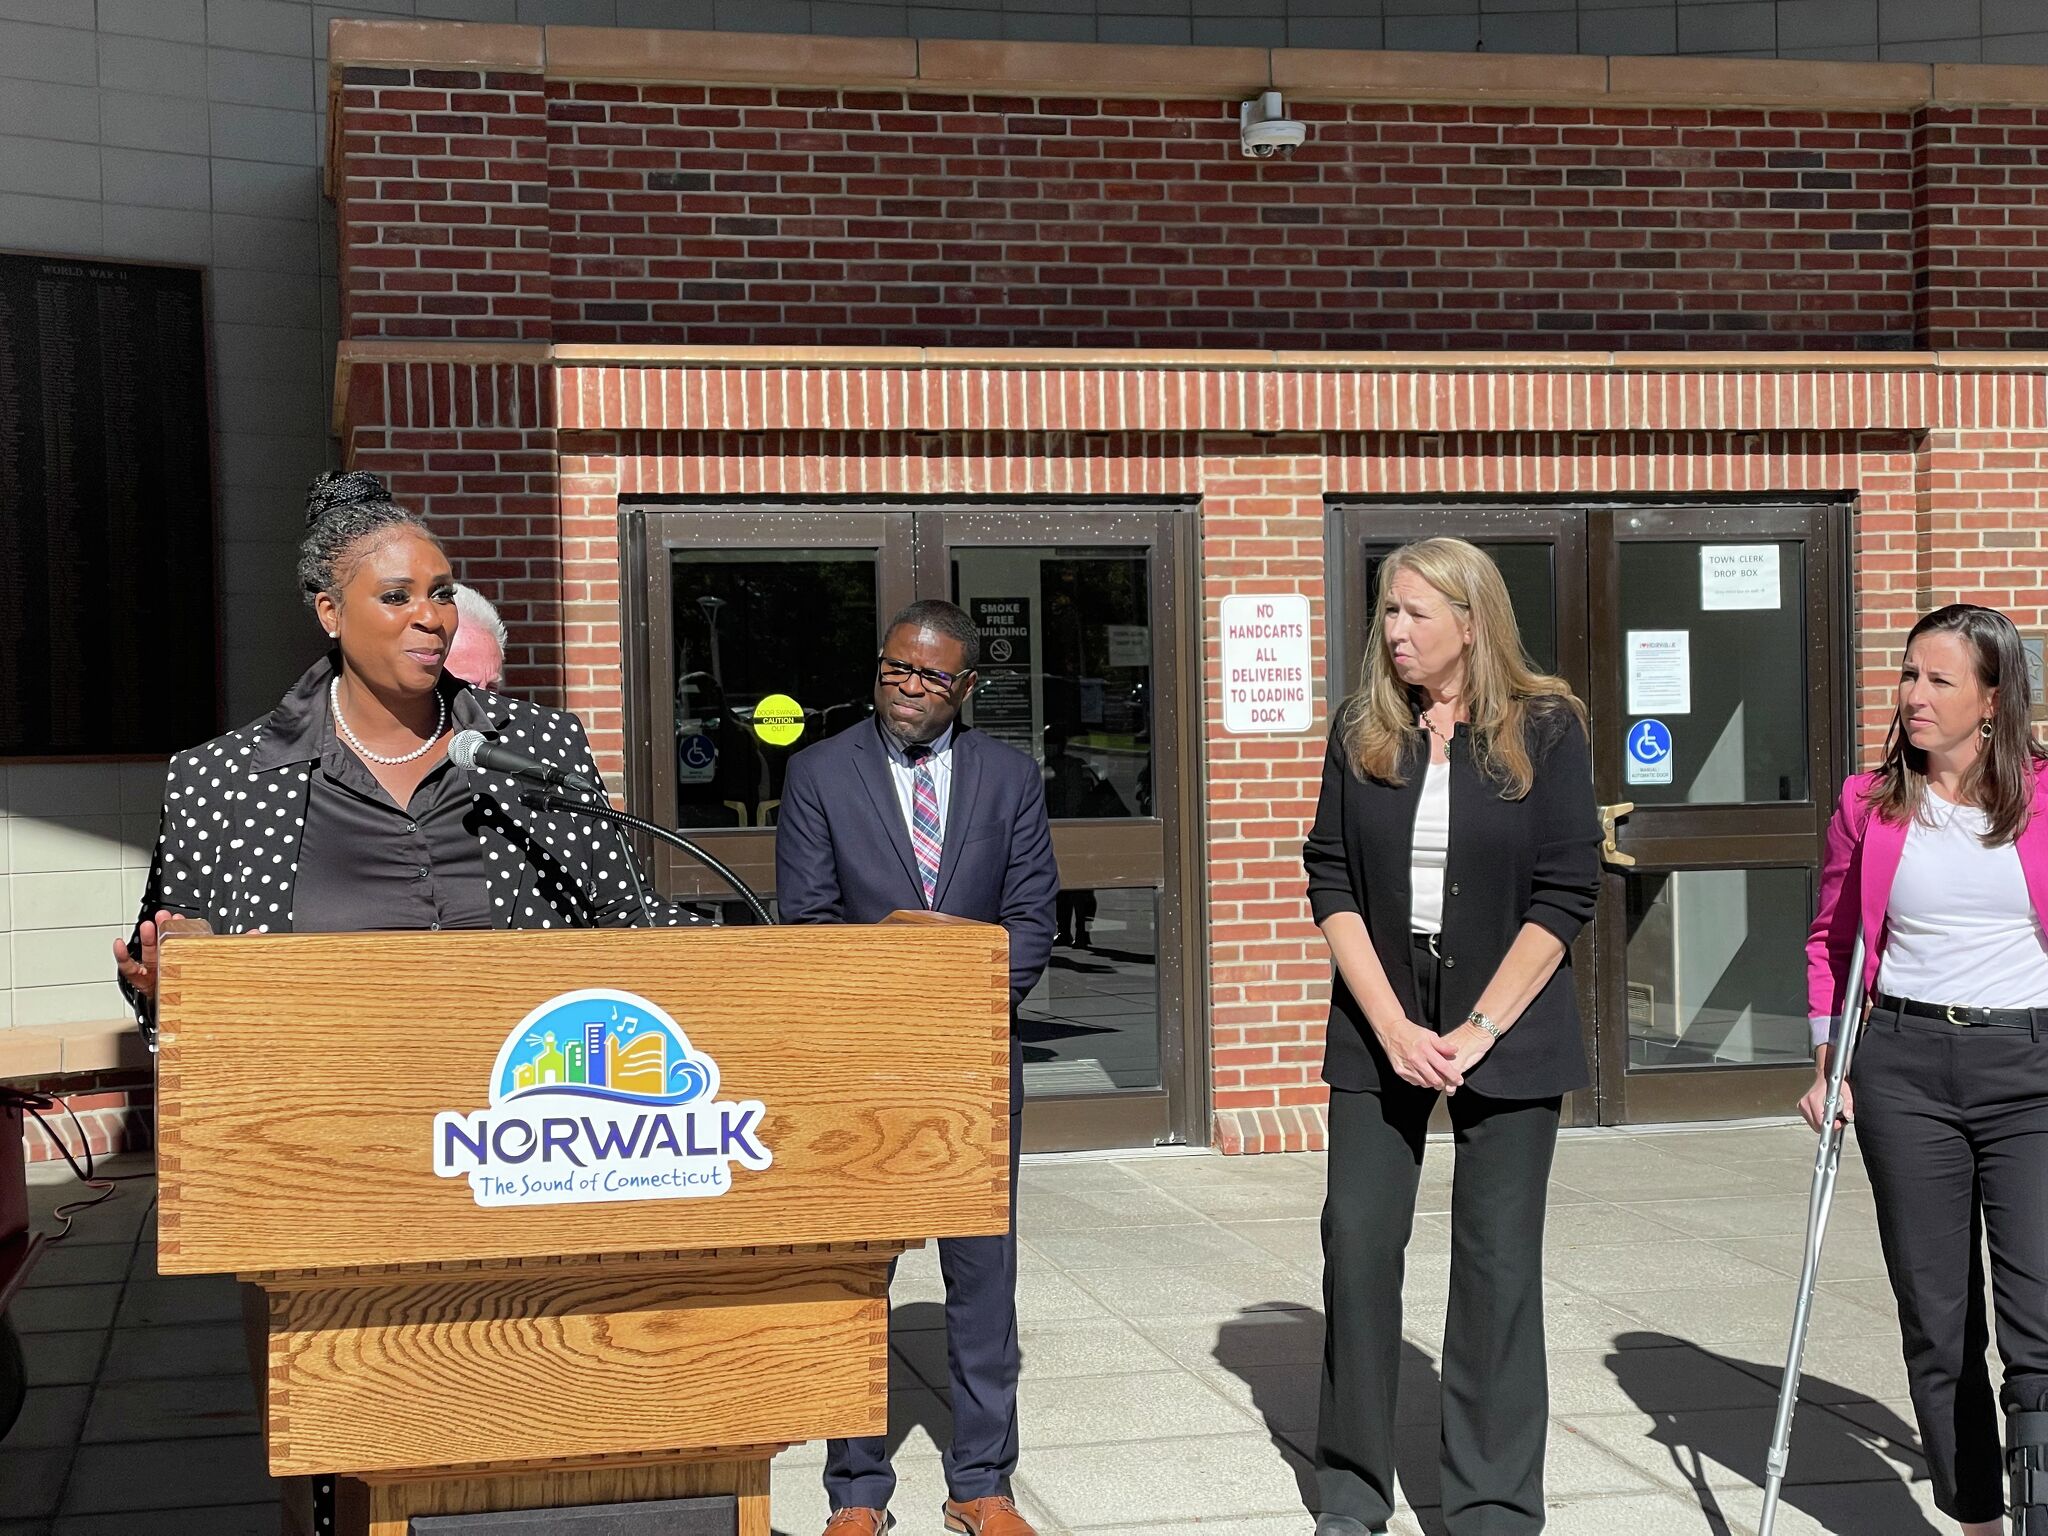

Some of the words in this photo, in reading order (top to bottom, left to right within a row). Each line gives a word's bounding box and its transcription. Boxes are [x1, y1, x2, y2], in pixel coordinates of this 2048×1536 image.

[42, 265, 83, 277] WORLD
[90, 269, 115, 279] WAR
[120, 271, 128, 280] II
[1709, 556, 1735, 564] TOWN
[1739, 555, 1764, 563] CLERK
[1714, 570, 1737, 578] DROP
[1741, 569, 1758, 577] BOX
[980, 603, 1020, 613] SMOKE
[1257, 604, 1274, 618] NO
[986, 615, 1015, 625] FREE
[1229, 624, 1303, 639] HANDCARTS
[1256, 648, 1277, 661] ALL
[1232, 667, 1302, 682] DELIVERIES
[1231, 689, 1247, 703] TO
[1251, 687, 1304, 702] LOADING
[775, 708, 800, 716] SWINGS
[1251, 708, 1285, 722] DOCK
[444, 1110, 763, 1167] NORWALK
[480, 1175, 517, 1197] The
[520, 1170, 574, 1197] Sound
[579, 1168, 599, 1192] of
[604, 1165, 722, 1192] Connecticut
